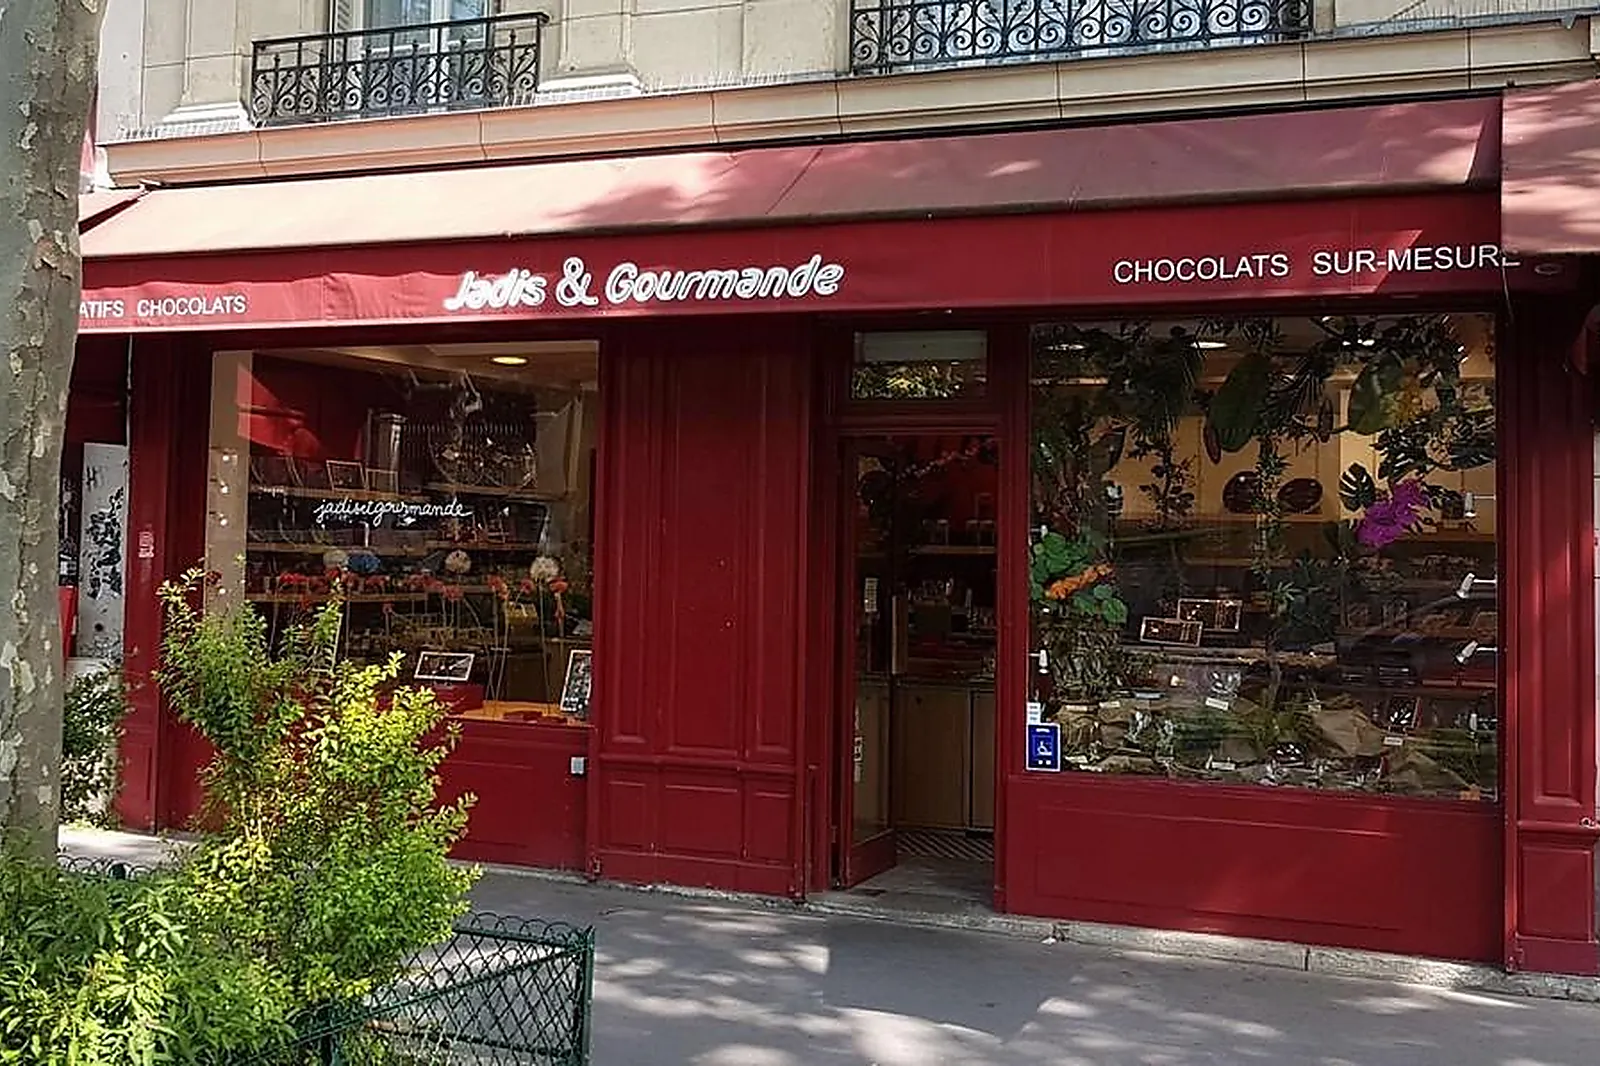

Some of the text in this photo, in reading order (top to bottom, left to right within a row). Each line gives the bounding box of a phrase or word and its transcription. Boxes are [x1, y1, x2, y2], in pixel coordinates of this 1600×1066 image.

[444, 254, 844, 311] Jadis & Gourmande
[1113, 253, 1289, 284] CHOCOLATS
[136, 295, 247, 318] CHOCOLATS
